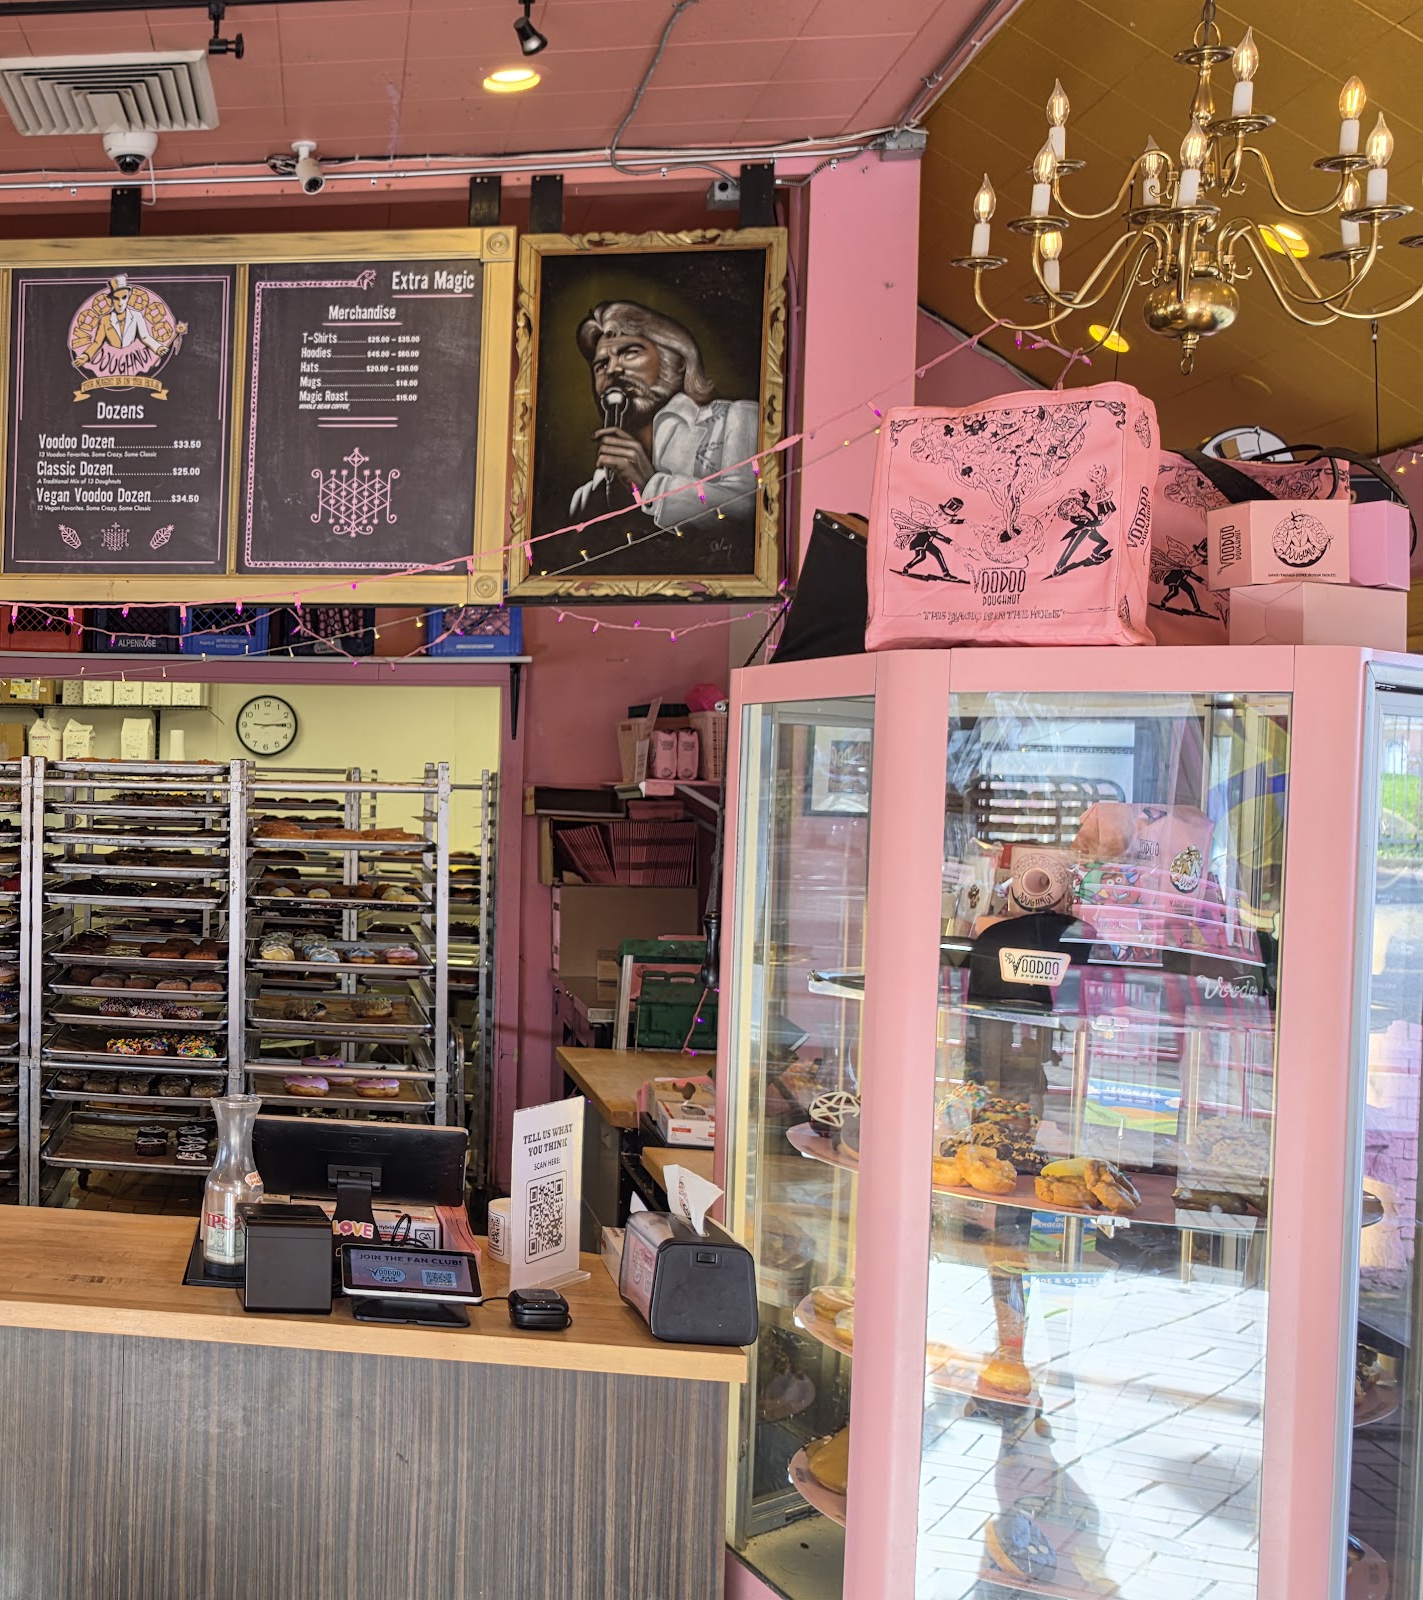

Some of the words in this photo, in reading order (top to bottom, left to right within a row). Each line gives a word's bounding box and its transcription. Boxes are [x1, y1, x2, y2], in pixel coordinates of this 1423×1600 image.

[392, 271, 428, 290] Extra
[434, 270, 474, 293] Magic
[329, 305, 396, 320] Merchandise
[303, 332, 337, 343] T-Shirts
[301, 347, 331, 358] Hoodies
[92, 347, 153, 375] DOUGHNUT
[301, 362, 319, 372] Hats
[300, 376, 321, 389] Mugs
[299, 391, 322, 404] Magic
[325, 391, 348, 401] Roast
[97, 402, 144, 419] Dozens
[39, 434, 77, 449] Voodoo
[82, 434, 115, 449] Dozen
[173, 440, 201, 448] $33.50
[37, 461, 75, 476] Classic
[80, 461, 113, 476] Dozen
[37, 488, 70, 505] Vegan
[75, 488, 113, 502] Voodoo
[118, 488, 151, 502] Dozen
[1127, 486, 1149, 549] VOODOO
[1217, 525, 1234, 576] VOODOO
[964, 563, 1026, 594] VOODOO
[982, 594, 1021, 606] DOUGHNUT
[118, 639, 156, 648] ALPENROSE
[1018, 892, 1054, 906] DOUGHNUT
[1005, 953, 1058, 977] VOODOO
[1106, 1086, 1139, 1095] LEMON
[523, 1132, 541, 1145] TELL
[542, 1129, 551, 1139] US
[552, 1123, 573, 1137] WHAT
[528, 1145, 543, 1157] YOU
[544, 1138, 567, 1152] THINK
[534, 1160, 547, 1171] SCAN
[548, 1158, 560, 1167] HERE:
[332, 1220, 374, 1239] LOVE
